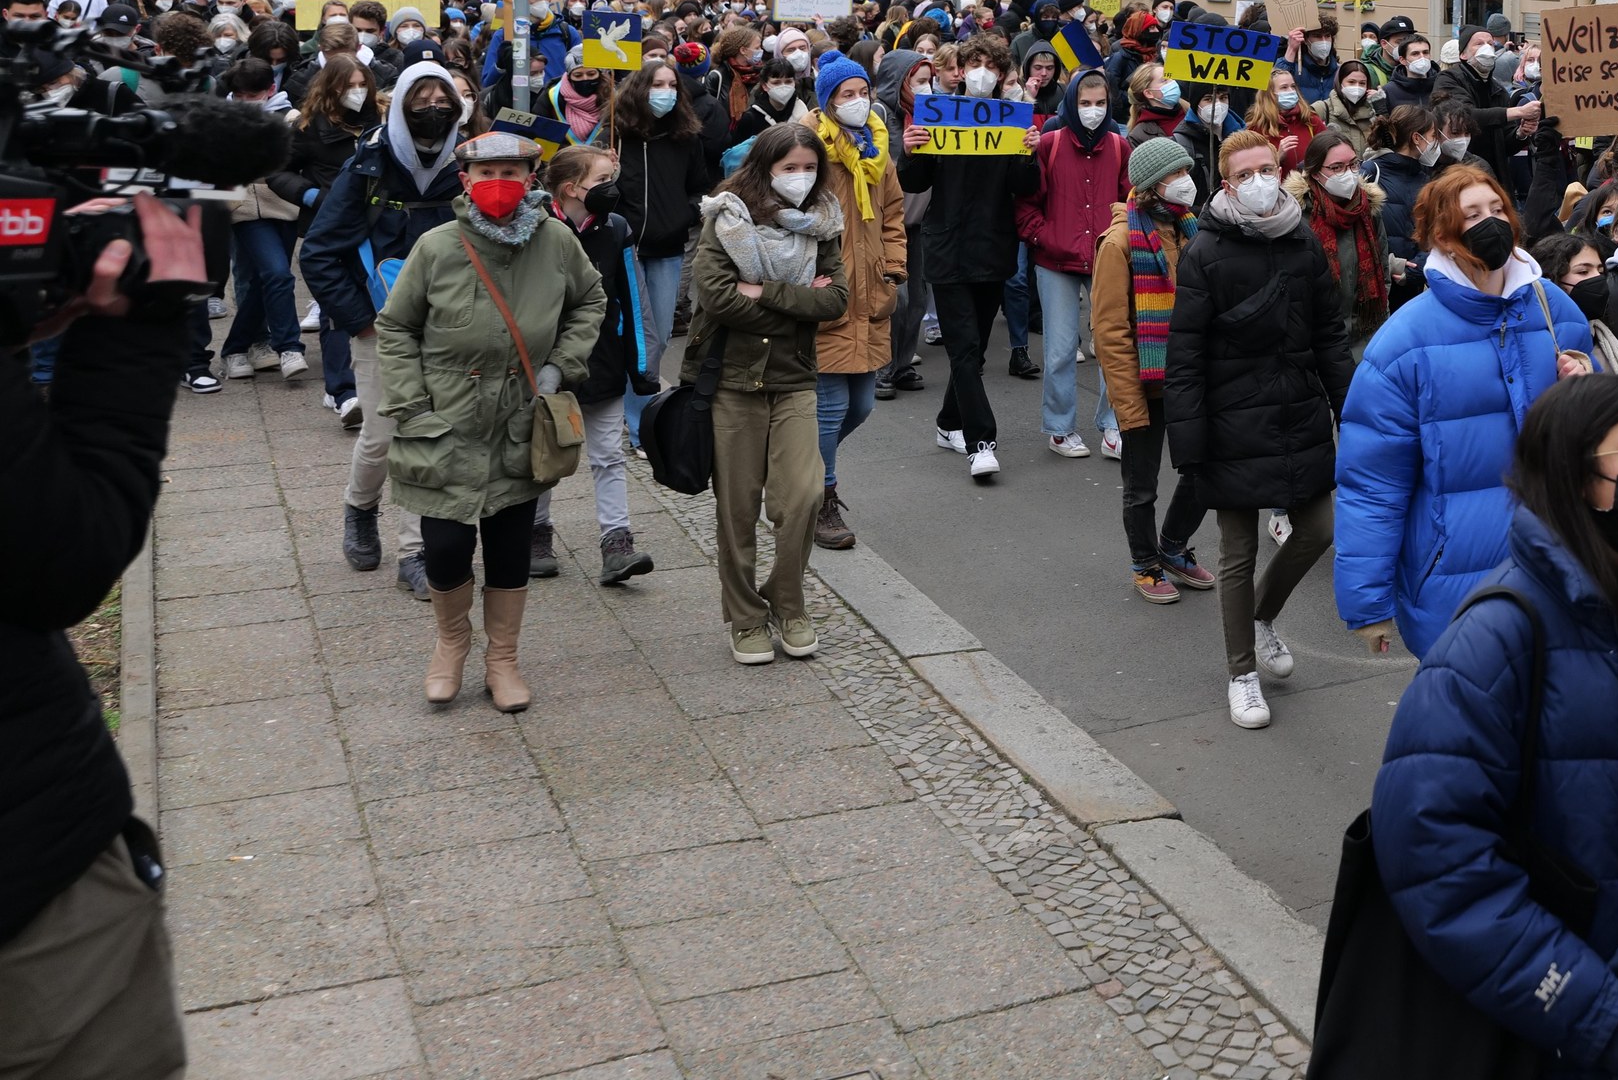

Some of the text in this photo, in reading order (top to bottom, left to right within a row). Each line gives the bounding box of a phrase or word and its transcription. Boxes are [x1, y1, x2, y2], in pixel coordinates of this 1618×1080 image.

[1179, 24, 1271, 55] STOP
[1544, 16, 1602, 53] Weil
[1188, 53, 1254, 81] WAR
[1552, 57, 1592, 84] leise
[923, 98, 1015, 124] STOP
[1534, 967, 1562, 1002] HH
